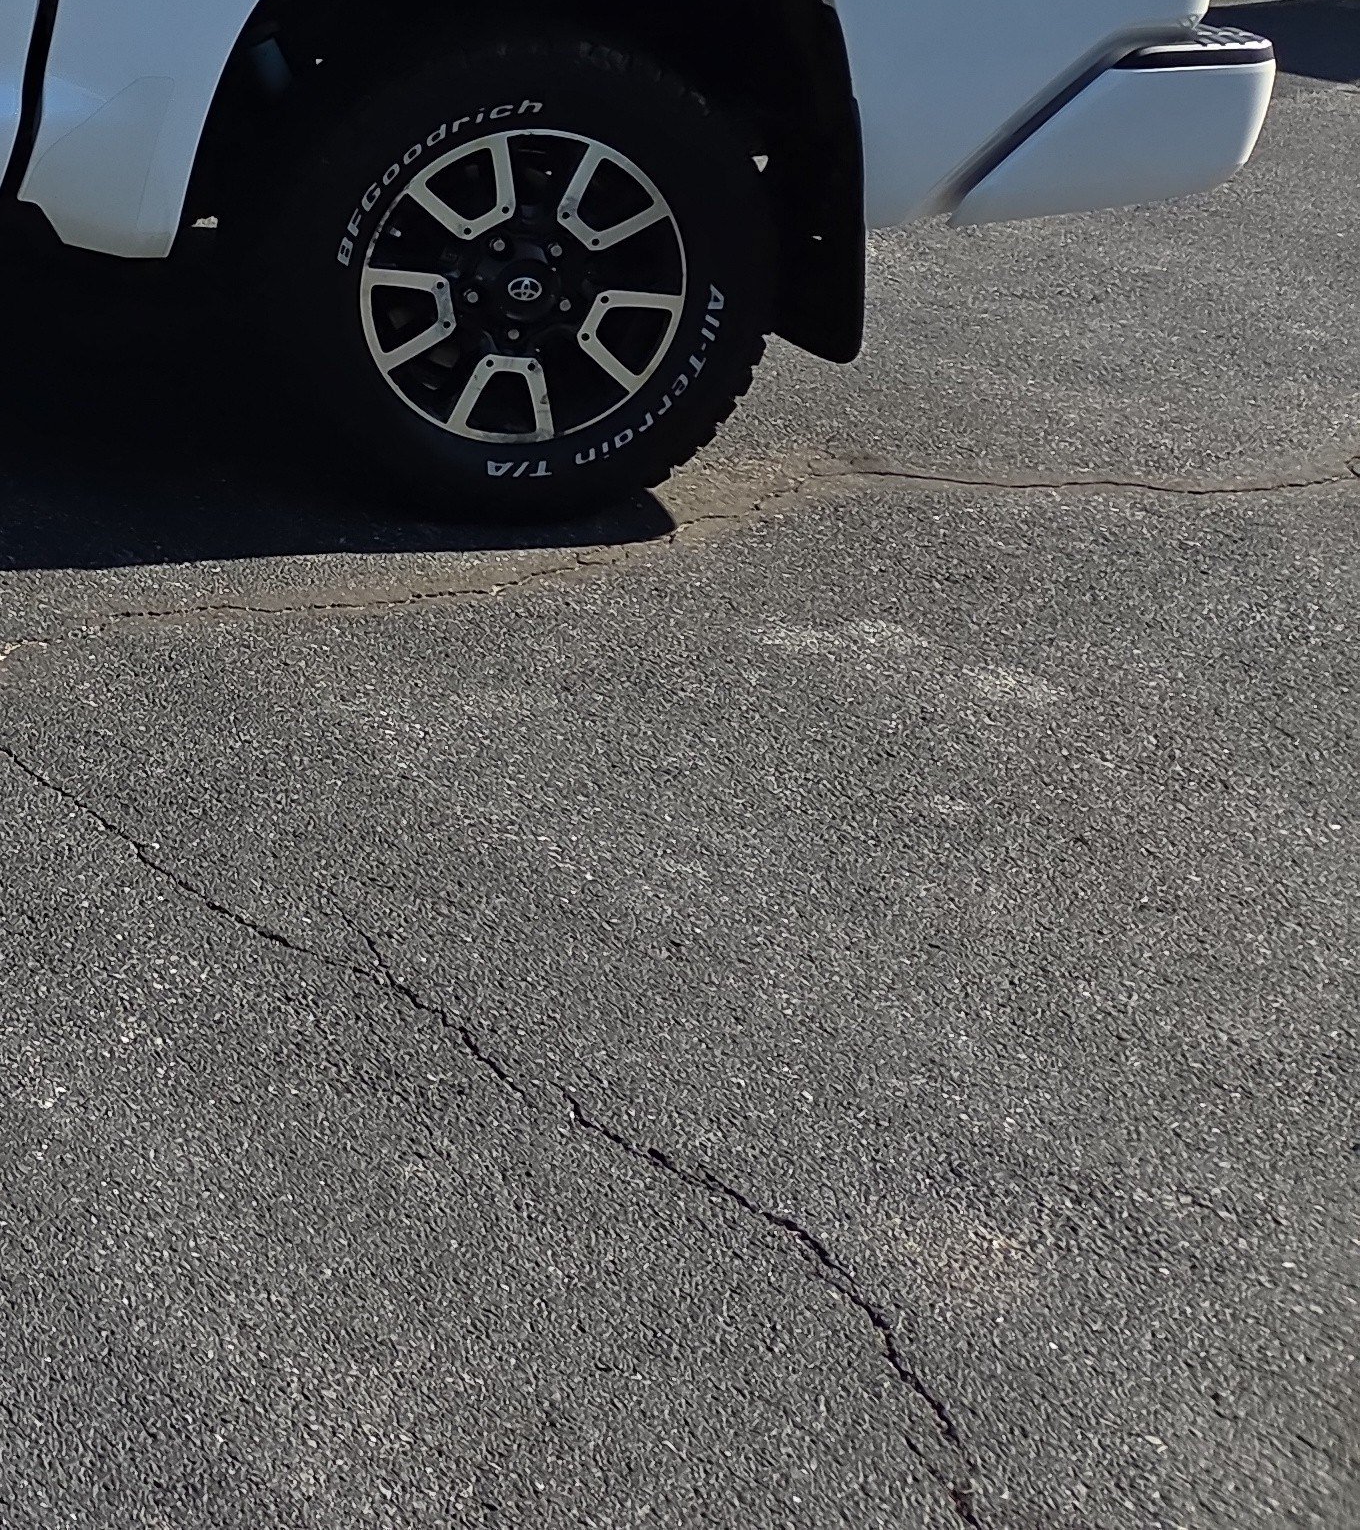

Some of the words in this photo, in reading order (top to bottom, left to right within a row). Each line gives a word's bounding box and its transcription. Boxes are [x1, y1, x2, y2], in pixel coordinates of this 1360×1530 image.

[336, 99, 544, 267] BFGoodrich
[574, 283, 726, 466] All-Terrain
[486, 458, 553, 478] T/A
